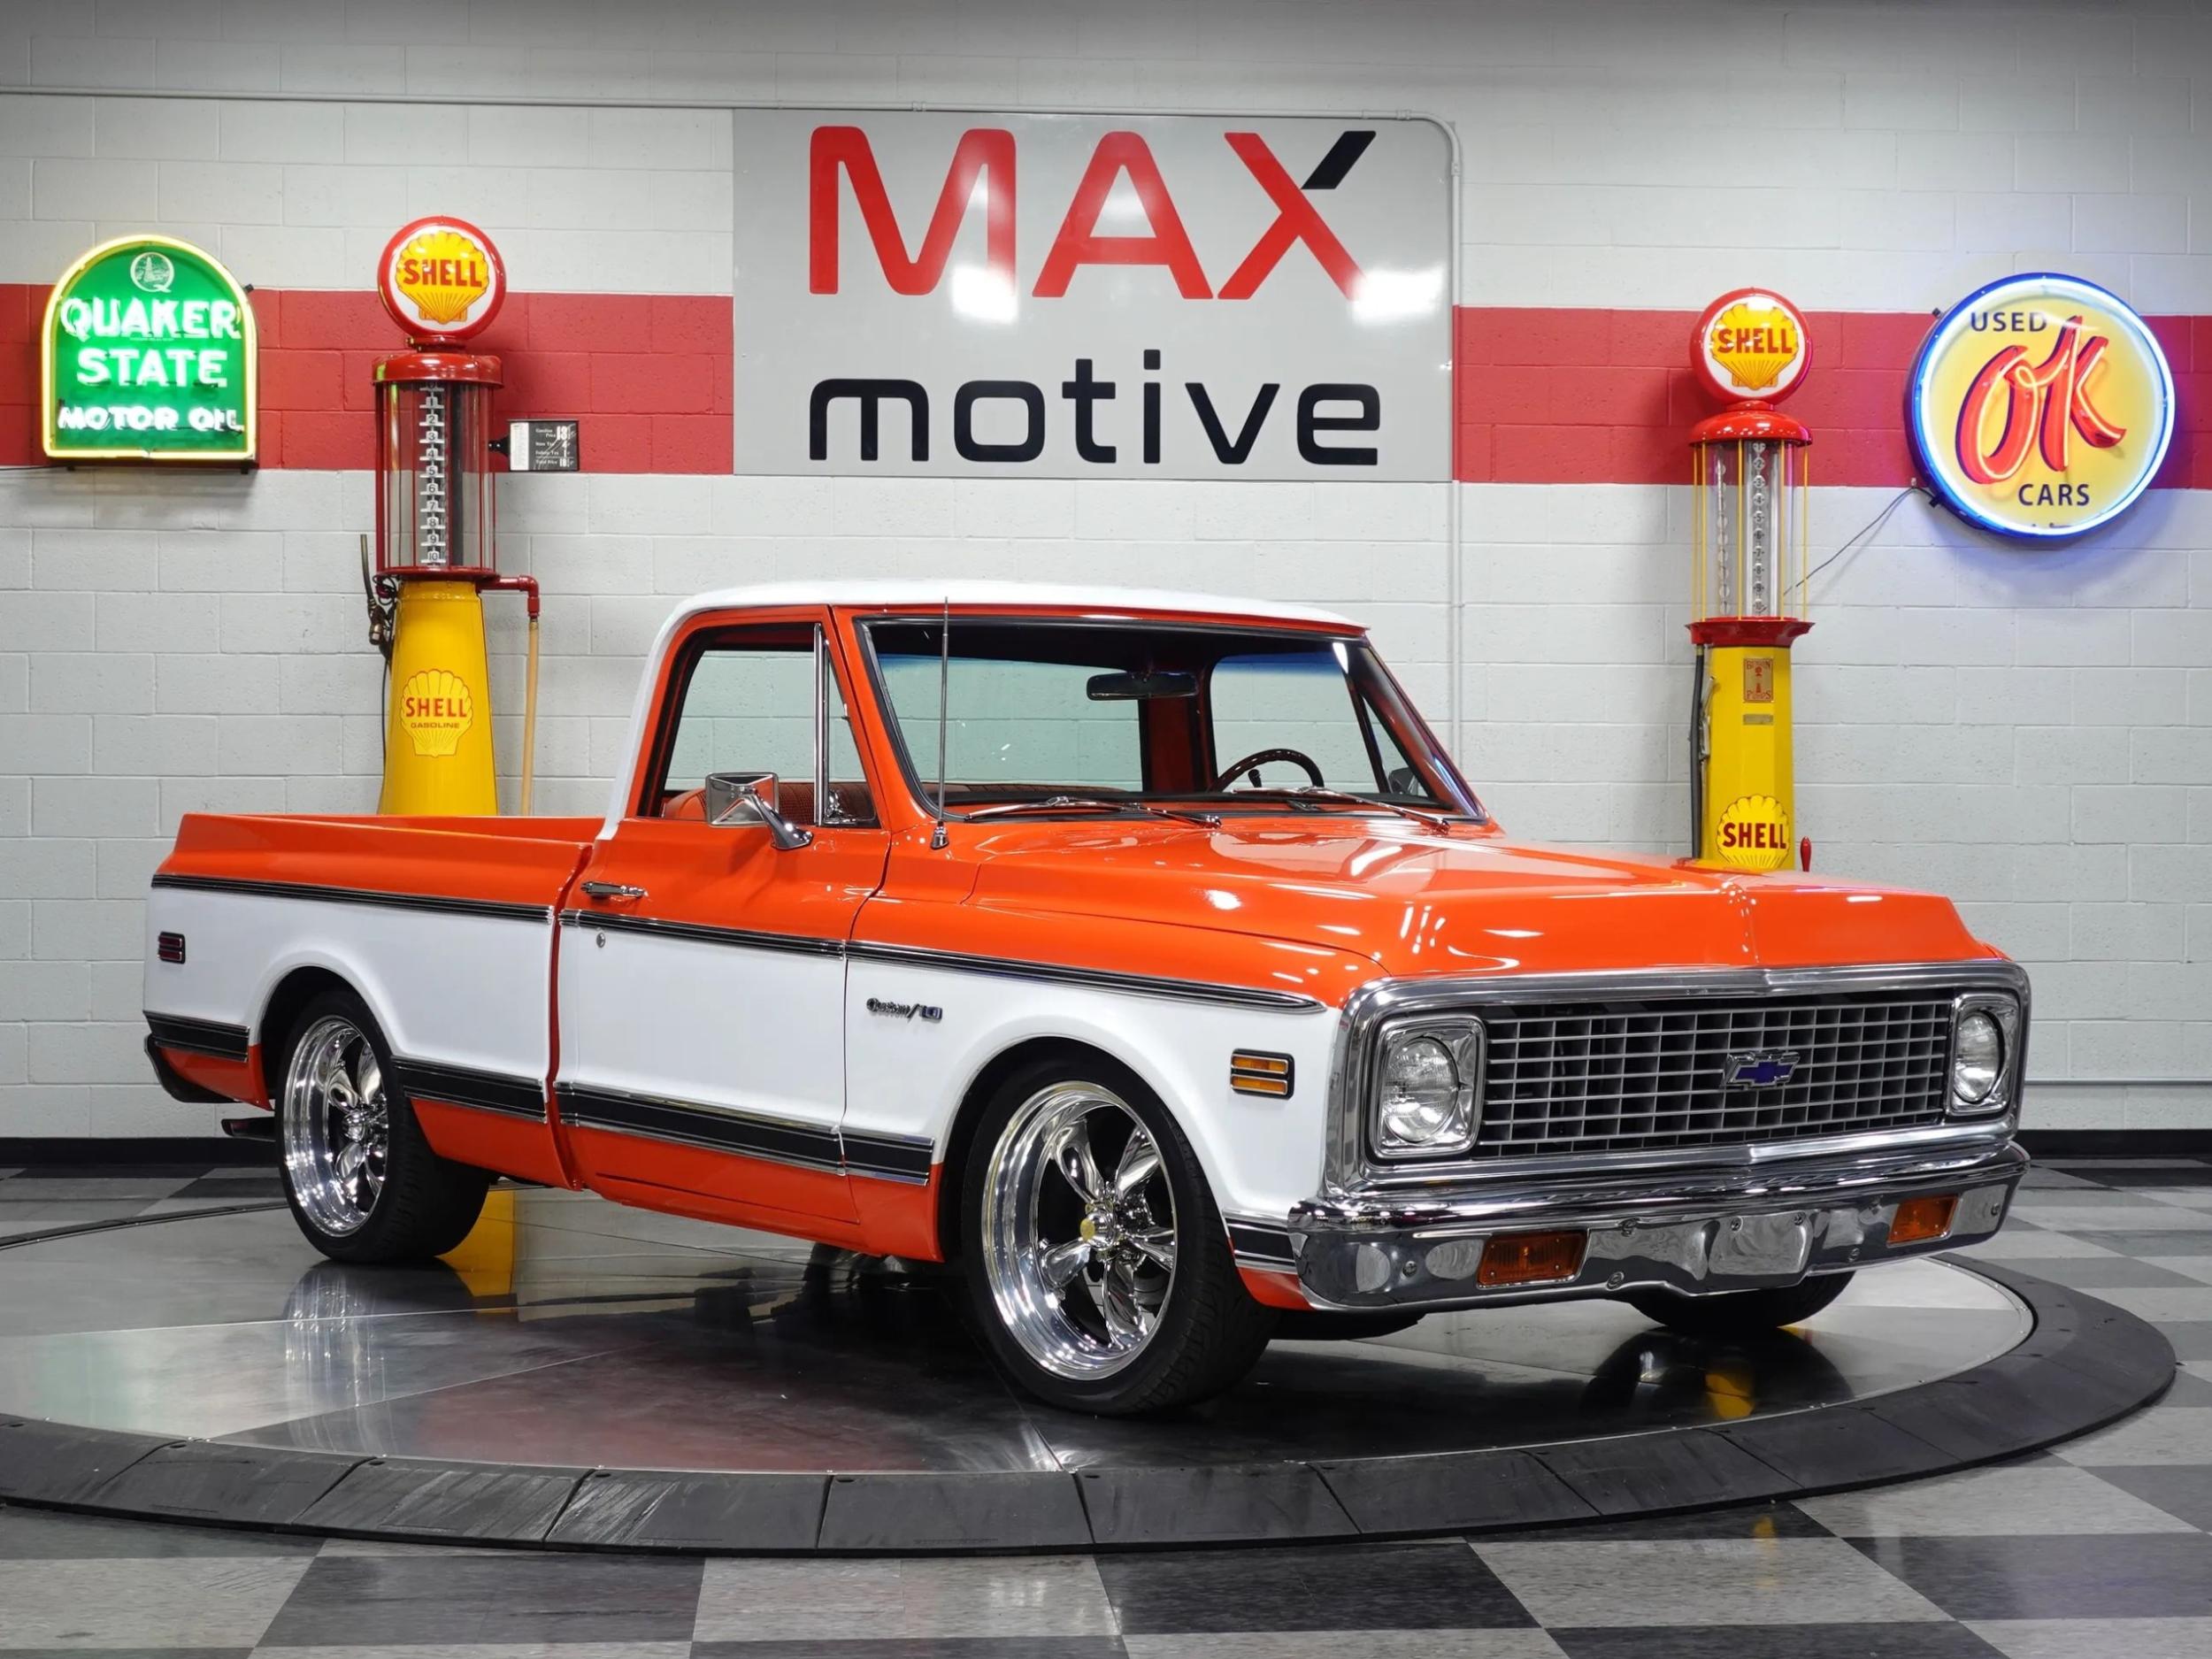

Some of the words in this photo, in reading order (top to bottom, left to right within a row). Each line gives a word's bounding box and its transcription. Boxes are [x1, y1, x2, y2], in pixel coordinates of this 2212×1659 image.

[809, 126, 1377, 301] MAX
[403, 258, 482, 288] SHELL
[60, 297, 242, 342] QUAKER
[1970, 311, 2047, 332] USED
[1717, 328, 1793, 354] SHELL
[77, 348, 227, 388] STATE
[809, 349, 1381, 466] motive
[1955, 315, 2127, 484] OK
[58, 405, 179, 430] MOTOR
[188, 406, 244, 431] OIL
[428, 415, 435, 424] 2
[428, 449, 434, 458] 4
[2018, 483, 2090, 506] CARS
[405, 696, 467, 718] SHELL
[1722, 822, 1786, 849] SHELL
